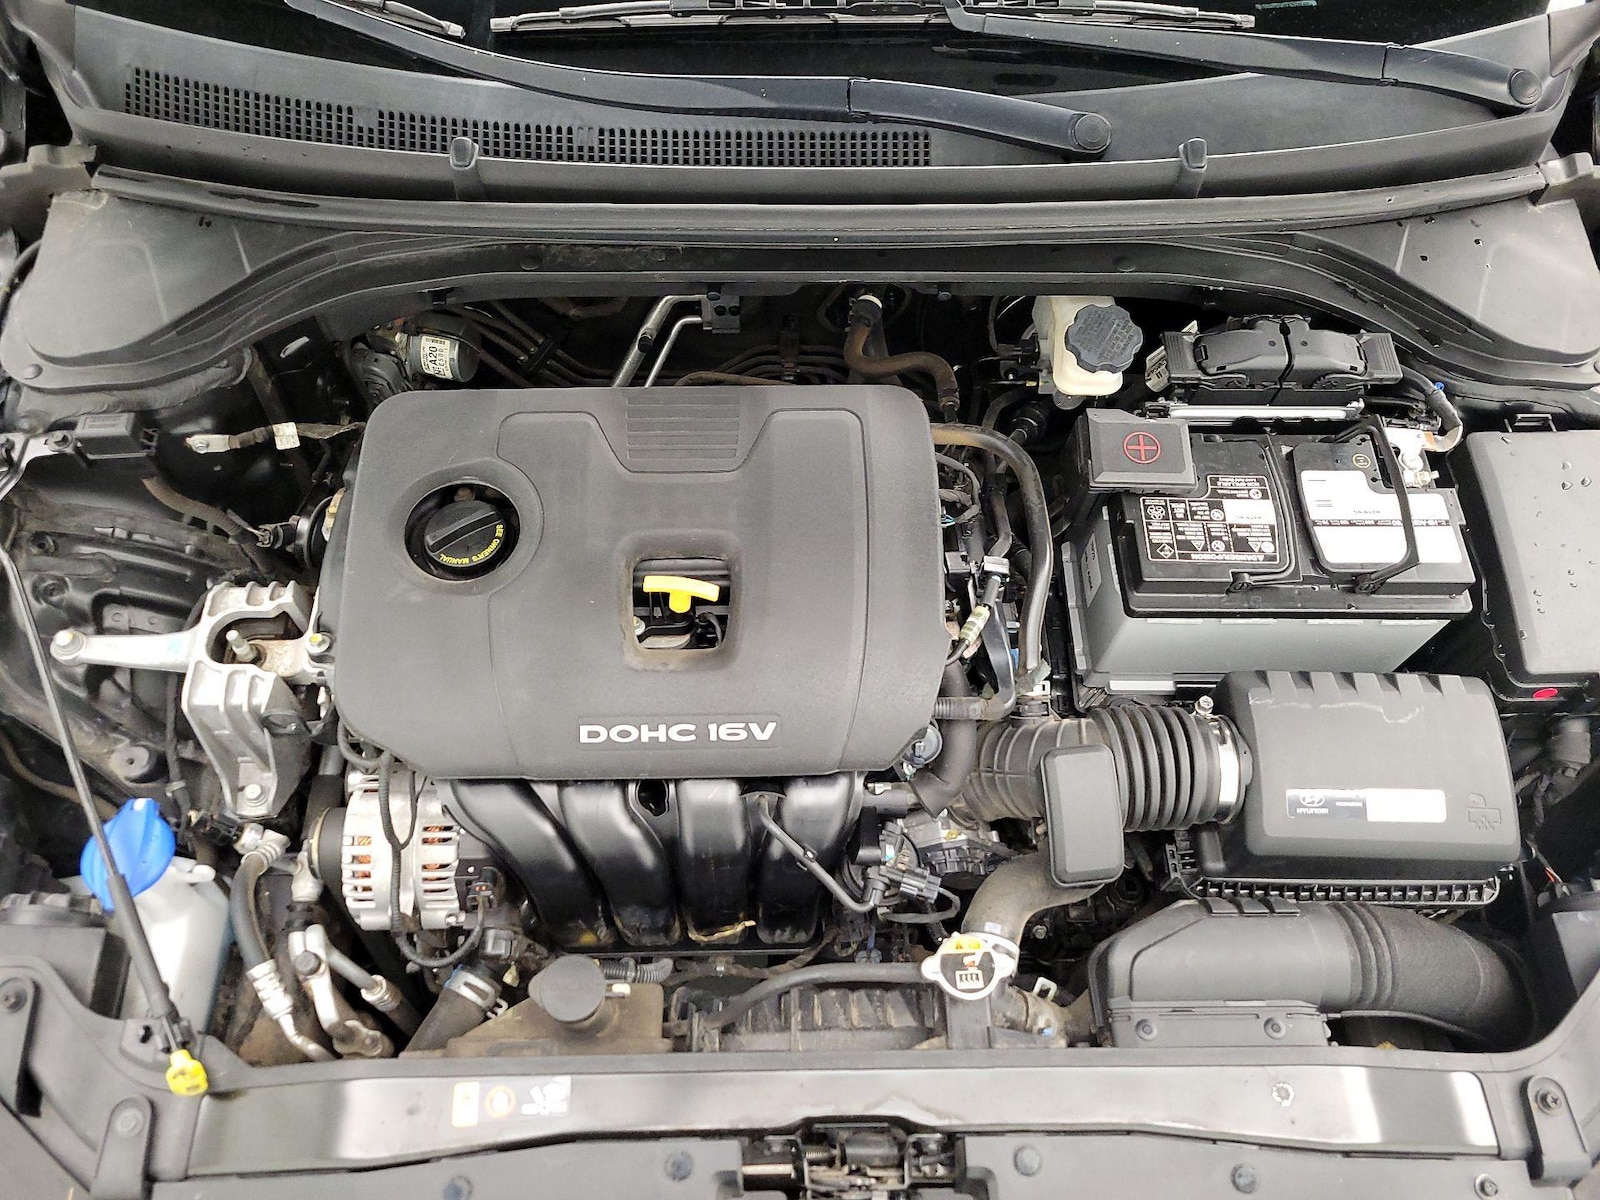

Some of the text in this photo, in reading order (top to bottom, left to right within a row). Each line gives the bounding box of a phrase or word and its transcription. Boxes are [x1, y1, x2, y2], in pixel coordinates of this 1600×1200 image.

[440, 524, 504, 564] SEE OWNER'S MANUAL
[579, 722, 777, 743] DOHC 16V
